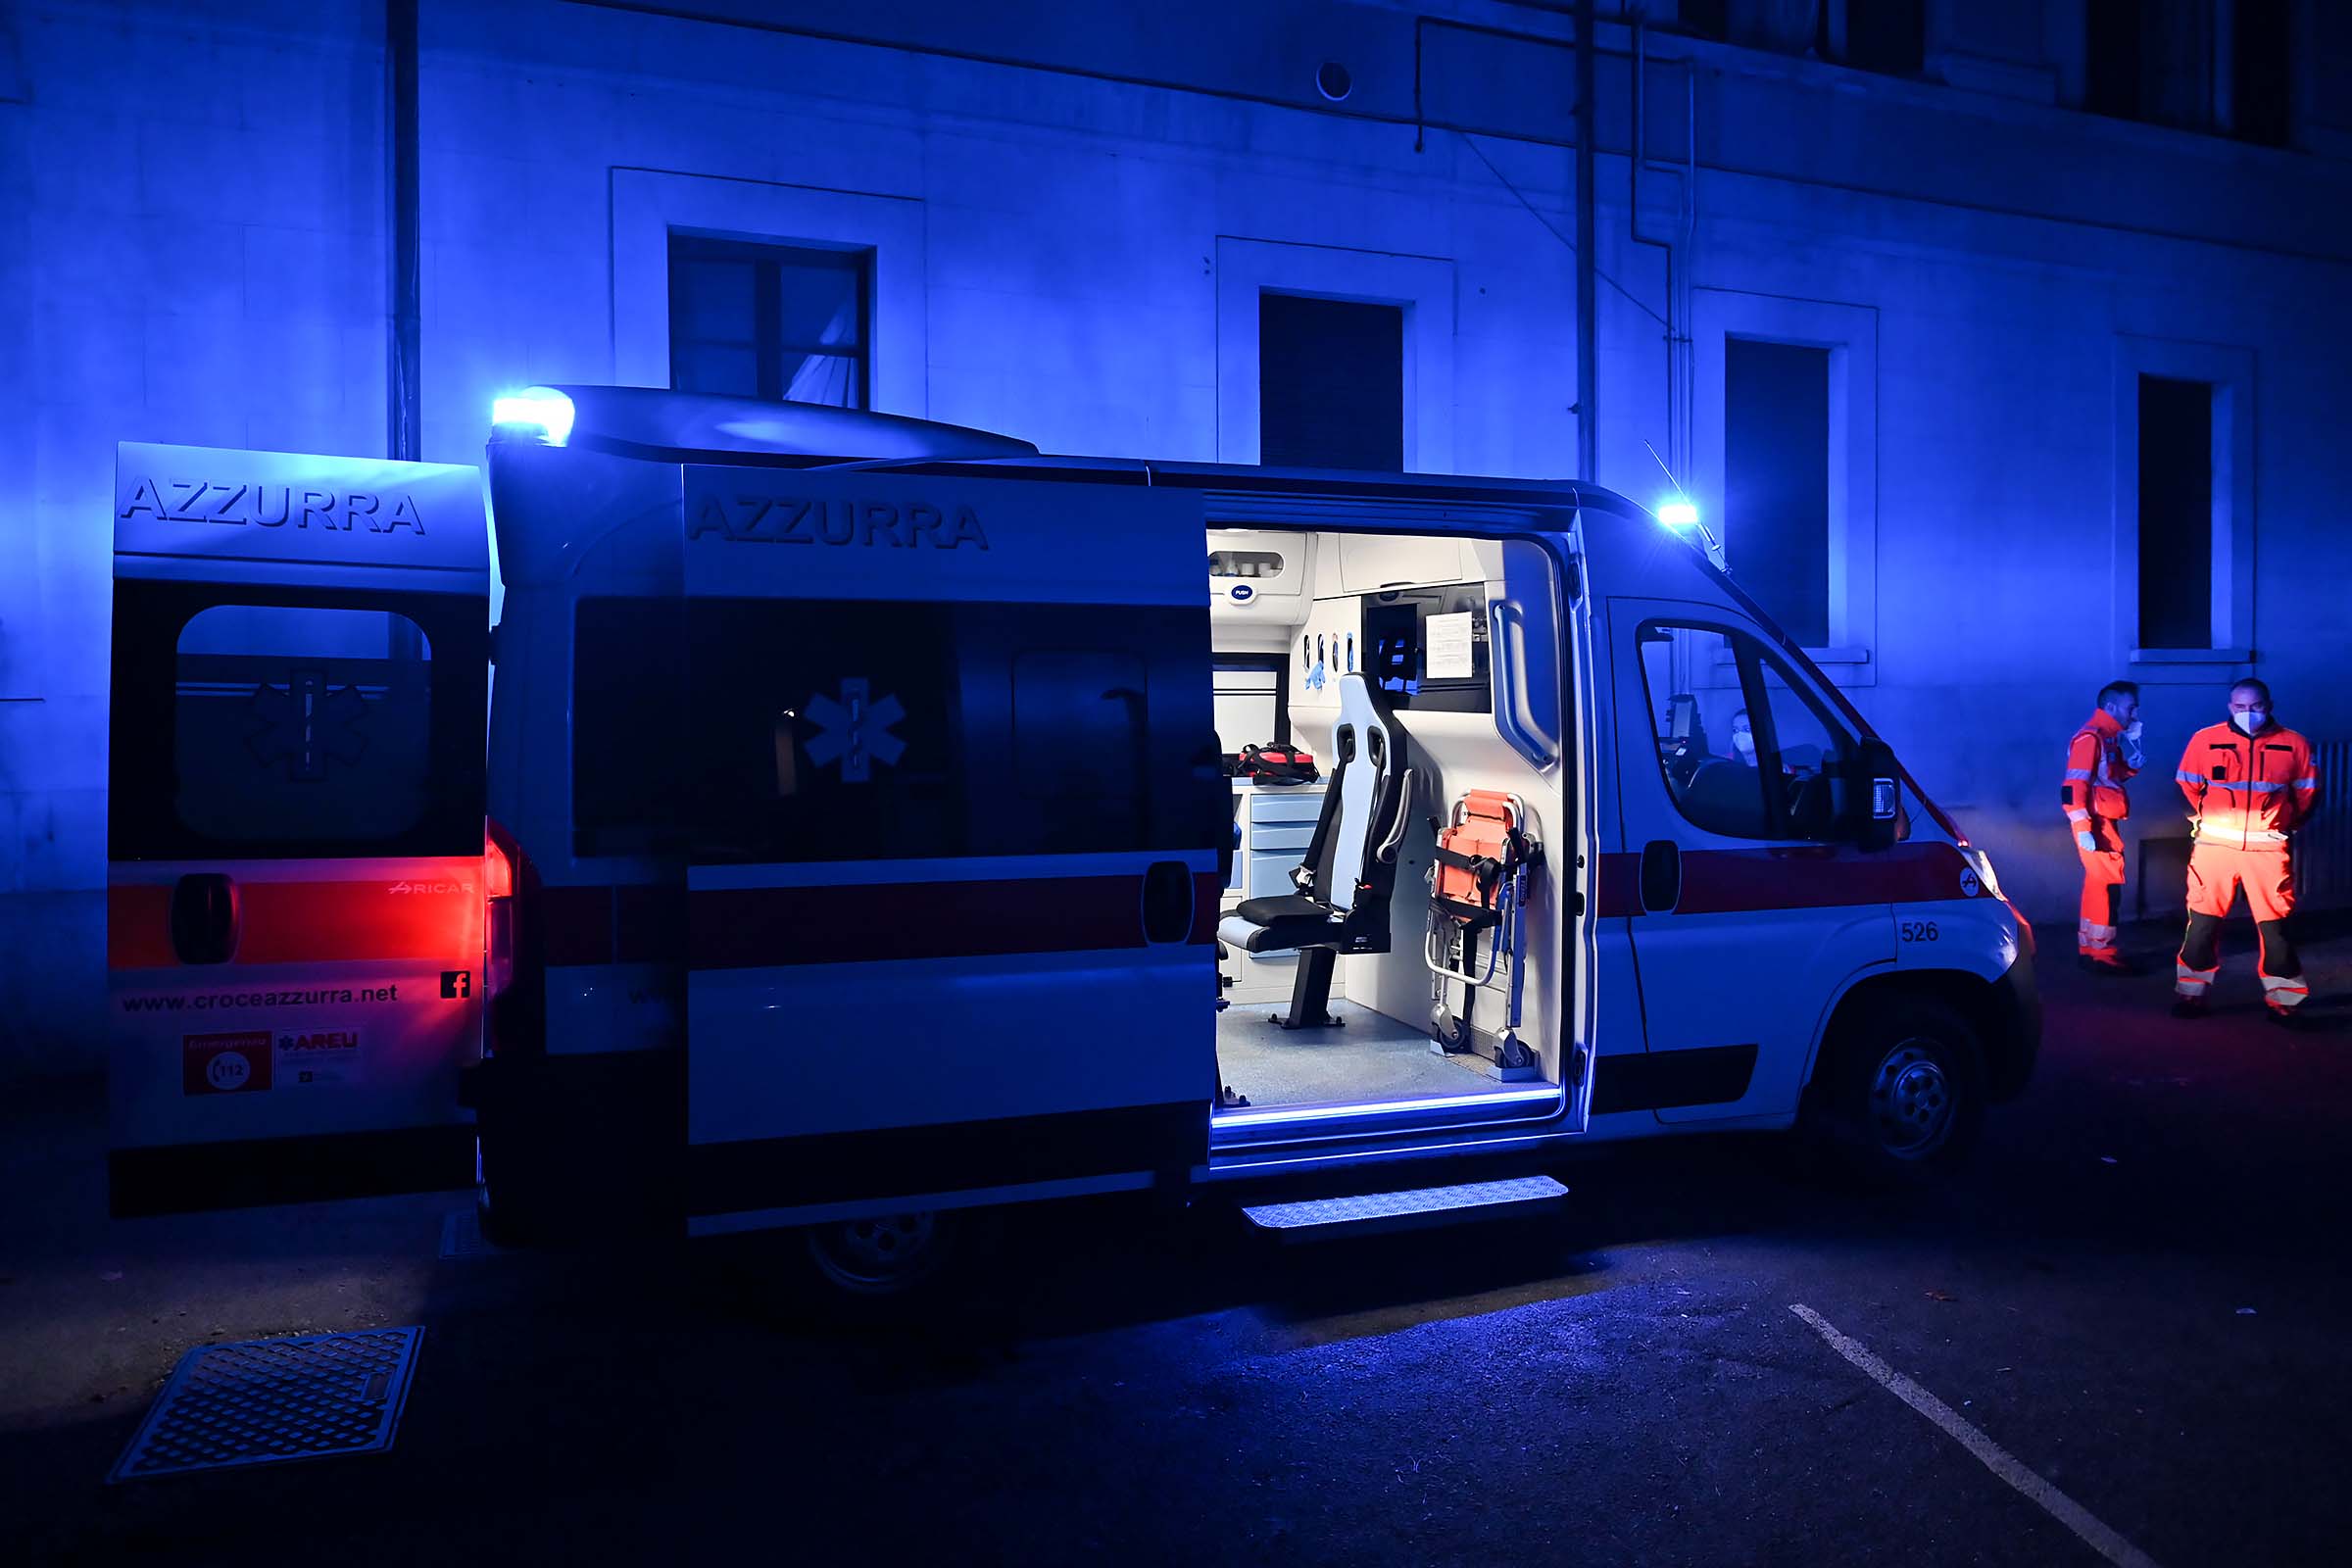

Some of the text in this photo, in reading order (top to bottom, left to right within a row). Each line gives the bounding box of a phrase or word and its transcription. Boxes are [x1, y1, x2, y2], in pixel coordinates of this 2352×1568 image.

[120, 477, 425, 535] AZZURRA
[689, 494, 989, 551] AZZURRA
[1901, 921, 1938, 942] 526
[123, 983, 398, 1011] www.croceazzurra.net
[294, 1032, 357, 1052] AREU
[220, 1064, 244, 1077] 112
